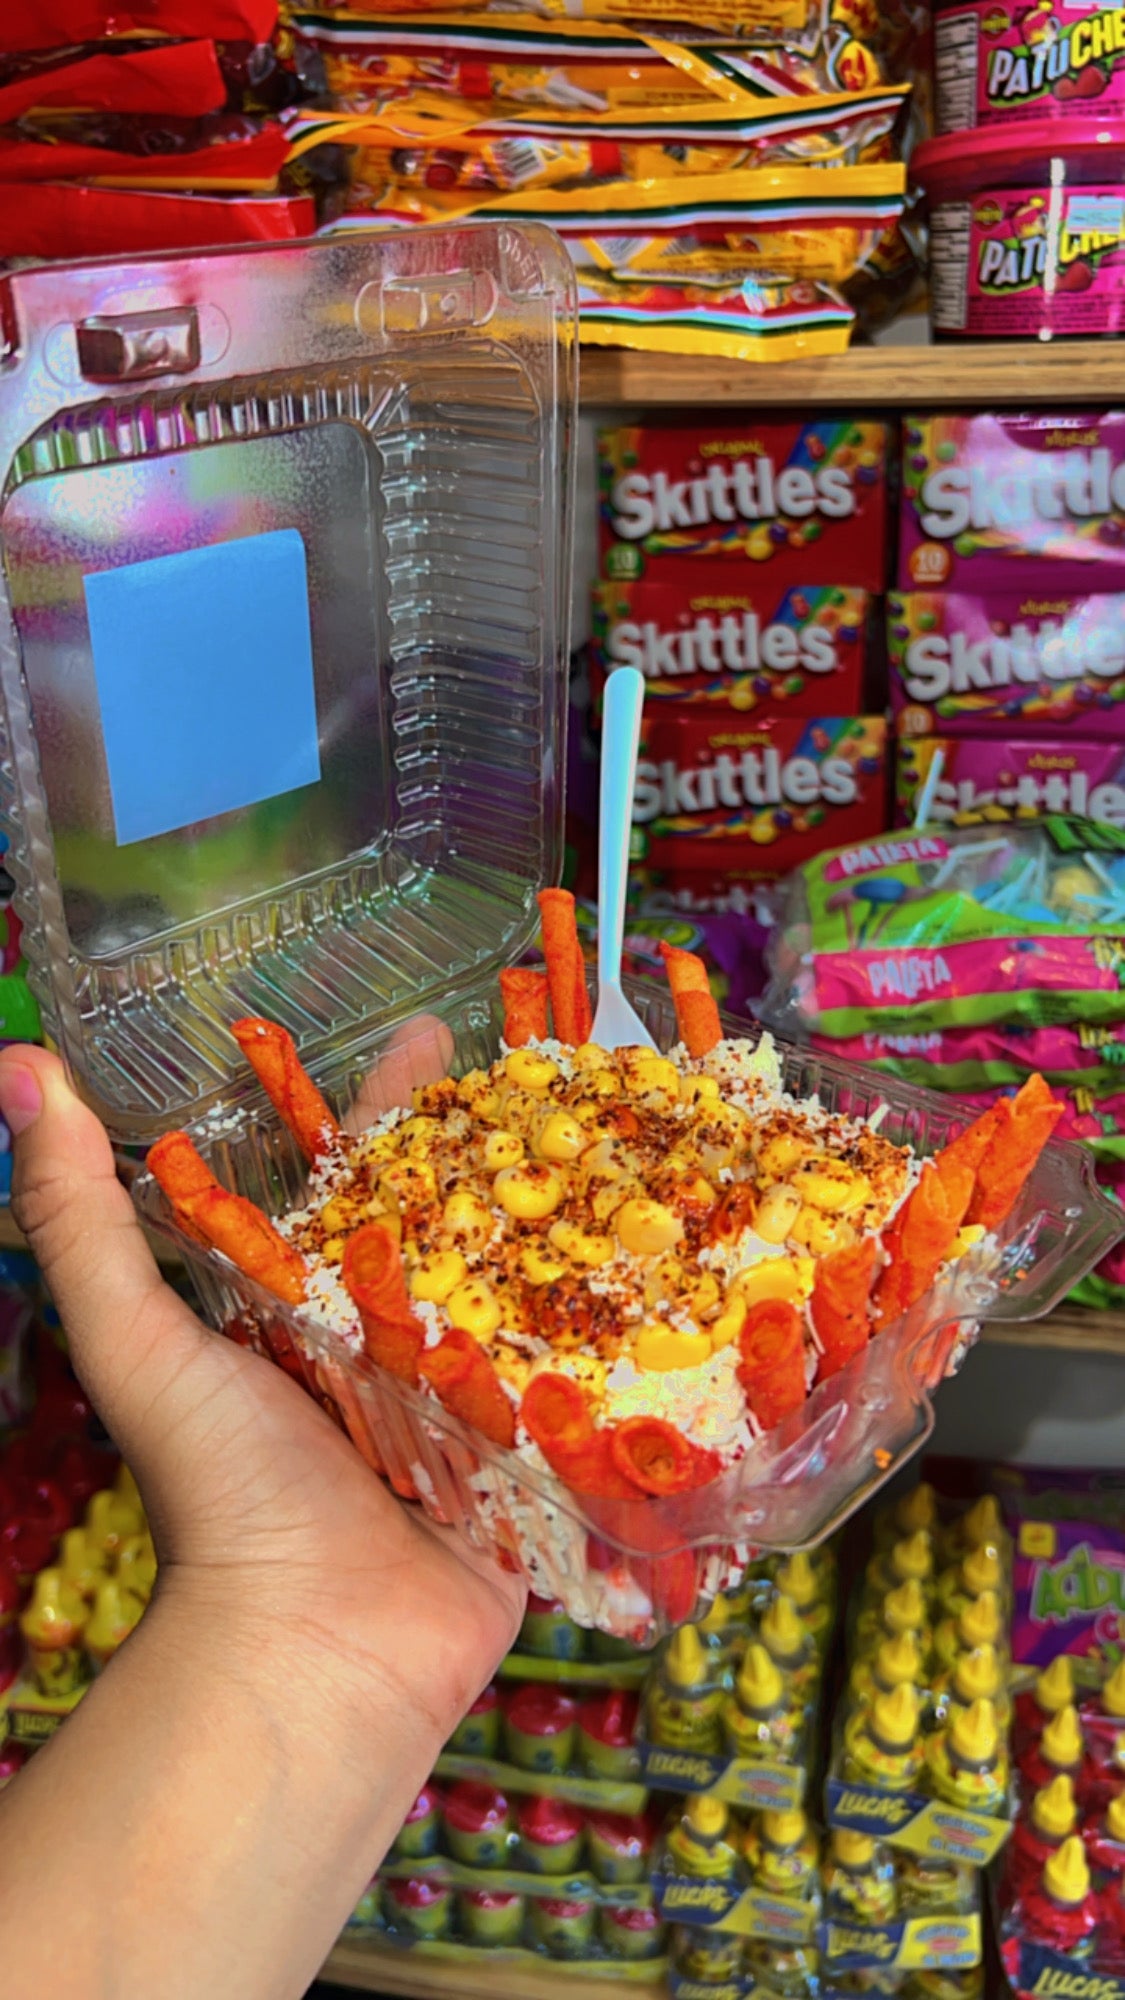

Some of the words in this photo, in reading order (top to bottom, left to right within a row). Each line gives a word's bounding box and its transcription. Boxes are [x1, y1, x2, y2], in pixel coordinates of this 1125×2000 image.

[612, 456, 856, 541] Skittles
[607, 612, 838, 678] Skittles
[631, 747, 857, 823] Skittles
[868, 954, 952, 999] PALETA
[834, 1790, 913, 1825] LUCAS
[1032, 1966, 1125, 2000] LUCAS
